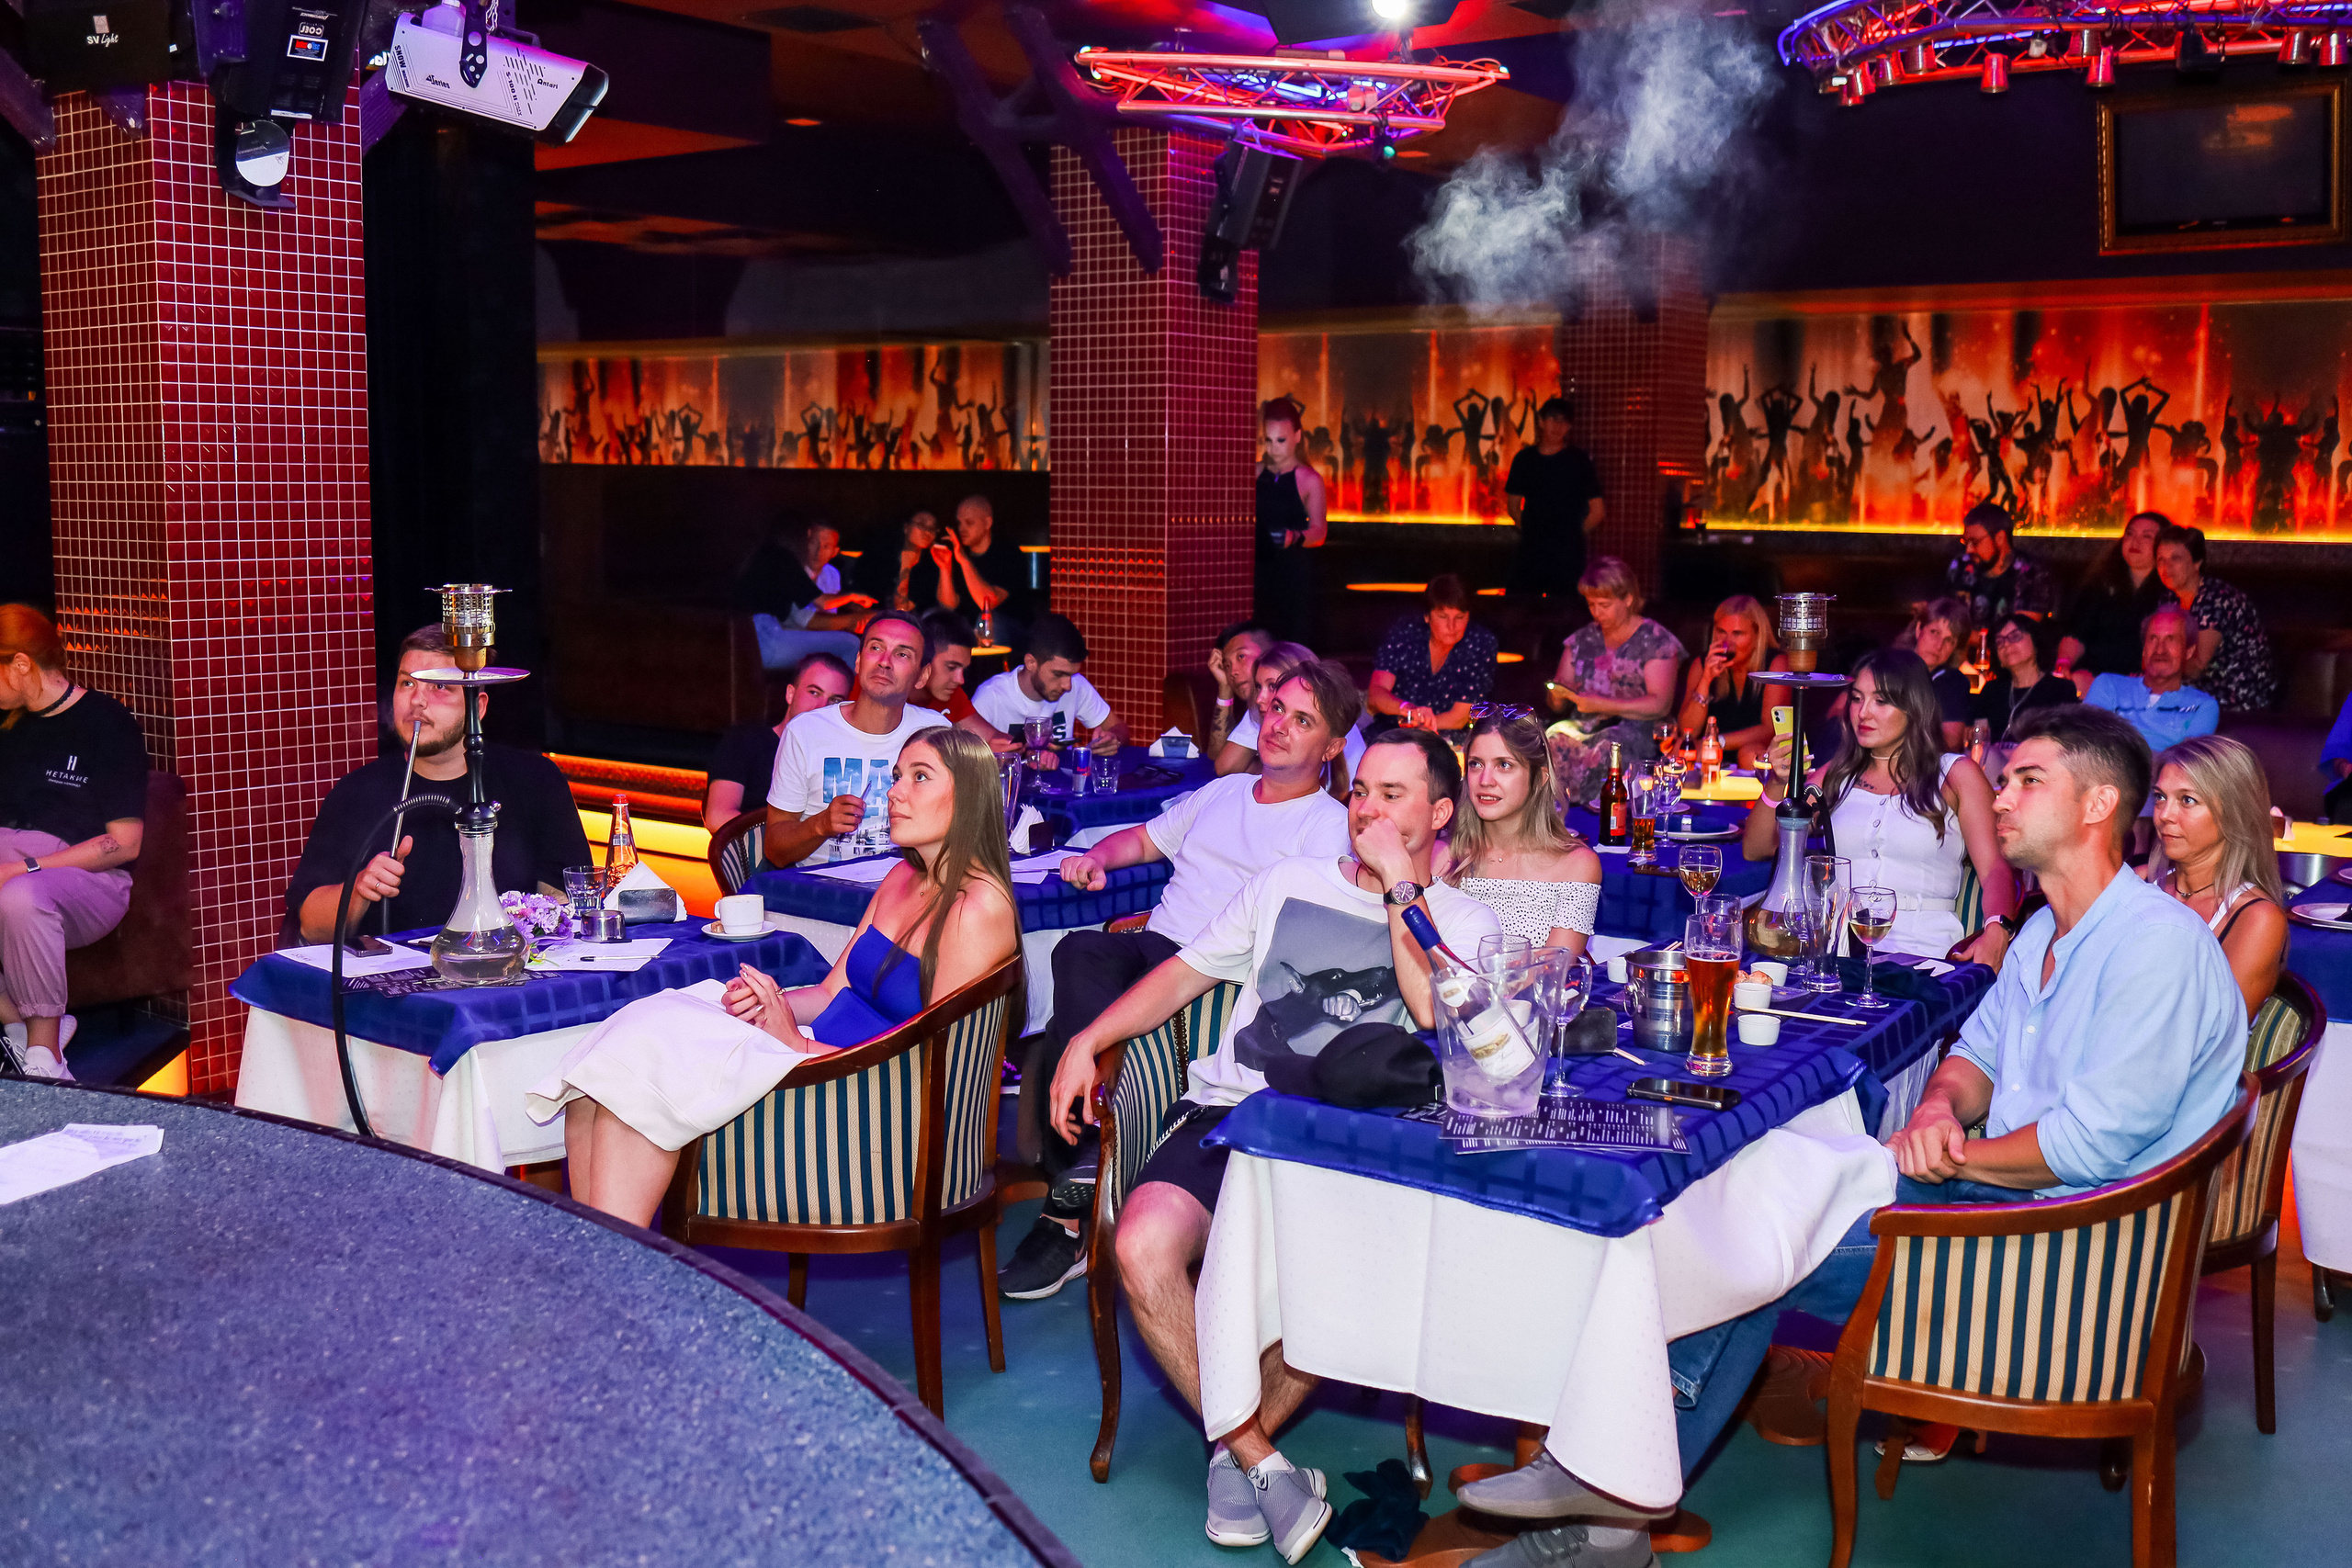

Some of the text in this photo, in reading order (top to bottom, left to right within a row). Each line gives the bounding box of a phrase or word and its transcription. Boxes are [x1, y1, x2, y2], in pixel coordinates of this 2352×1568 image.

[86, 33, 119, 48] SV Light
[394, 44, 407, 69] SNOW
[505, 71, 516, 94] S-100
[537, 78, 559, 89] Antari
[45, 769, 89, 784] НЕТАКИЕ
